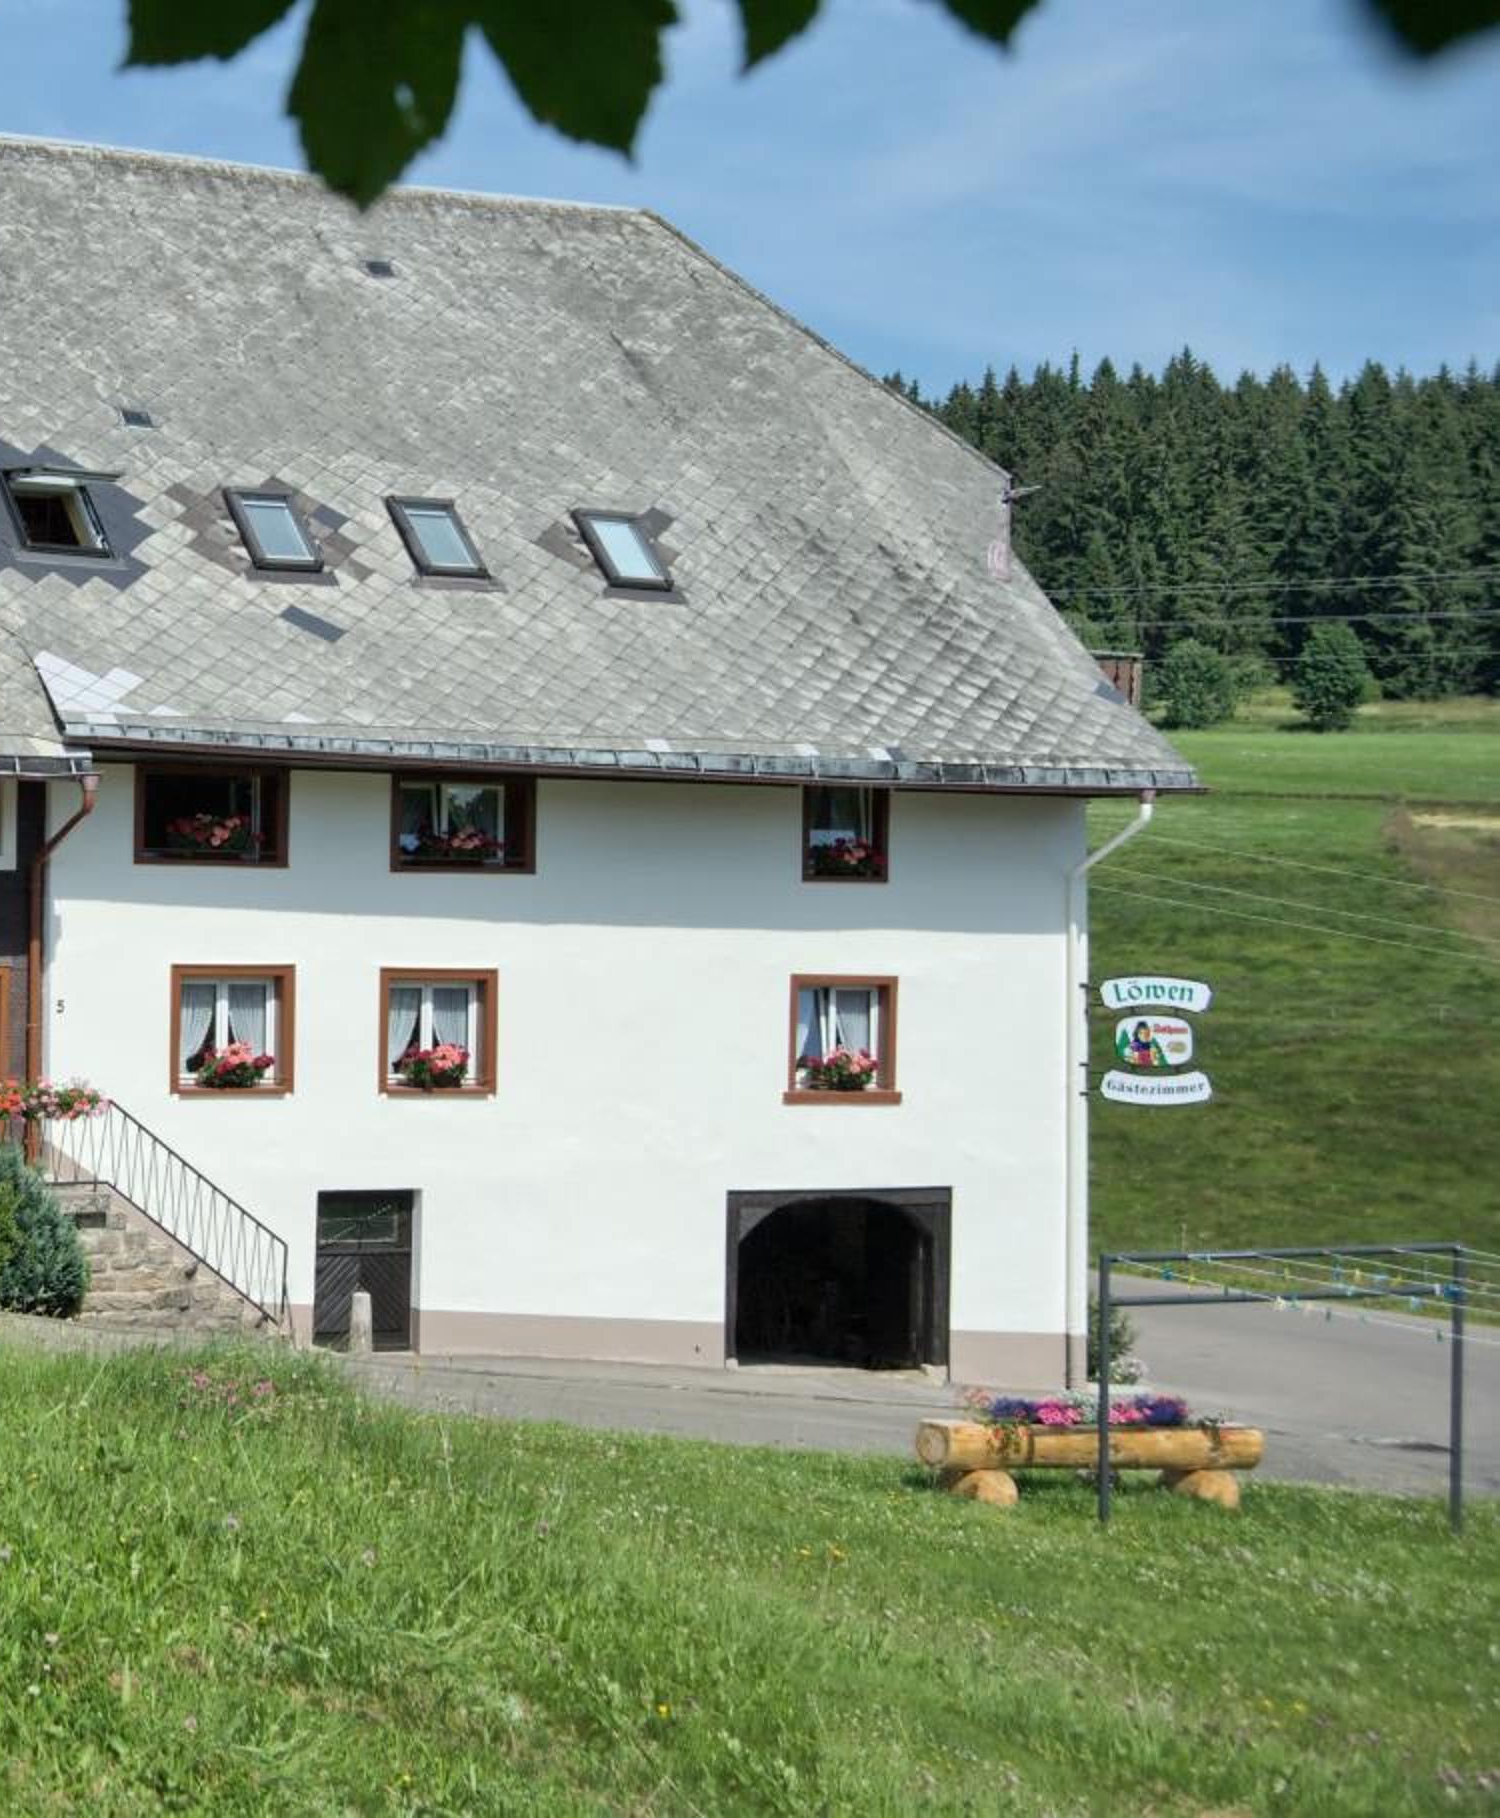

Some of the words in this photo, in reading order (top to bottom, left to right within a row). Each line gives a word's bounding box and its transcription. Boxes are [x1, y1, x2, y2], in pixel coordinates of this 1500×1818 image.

[1113, 981, 1194, 1002] Löwen
[56, 999, 65, 1014] 5
[1107, 1079, 1204, 1096] Gästezimmer
